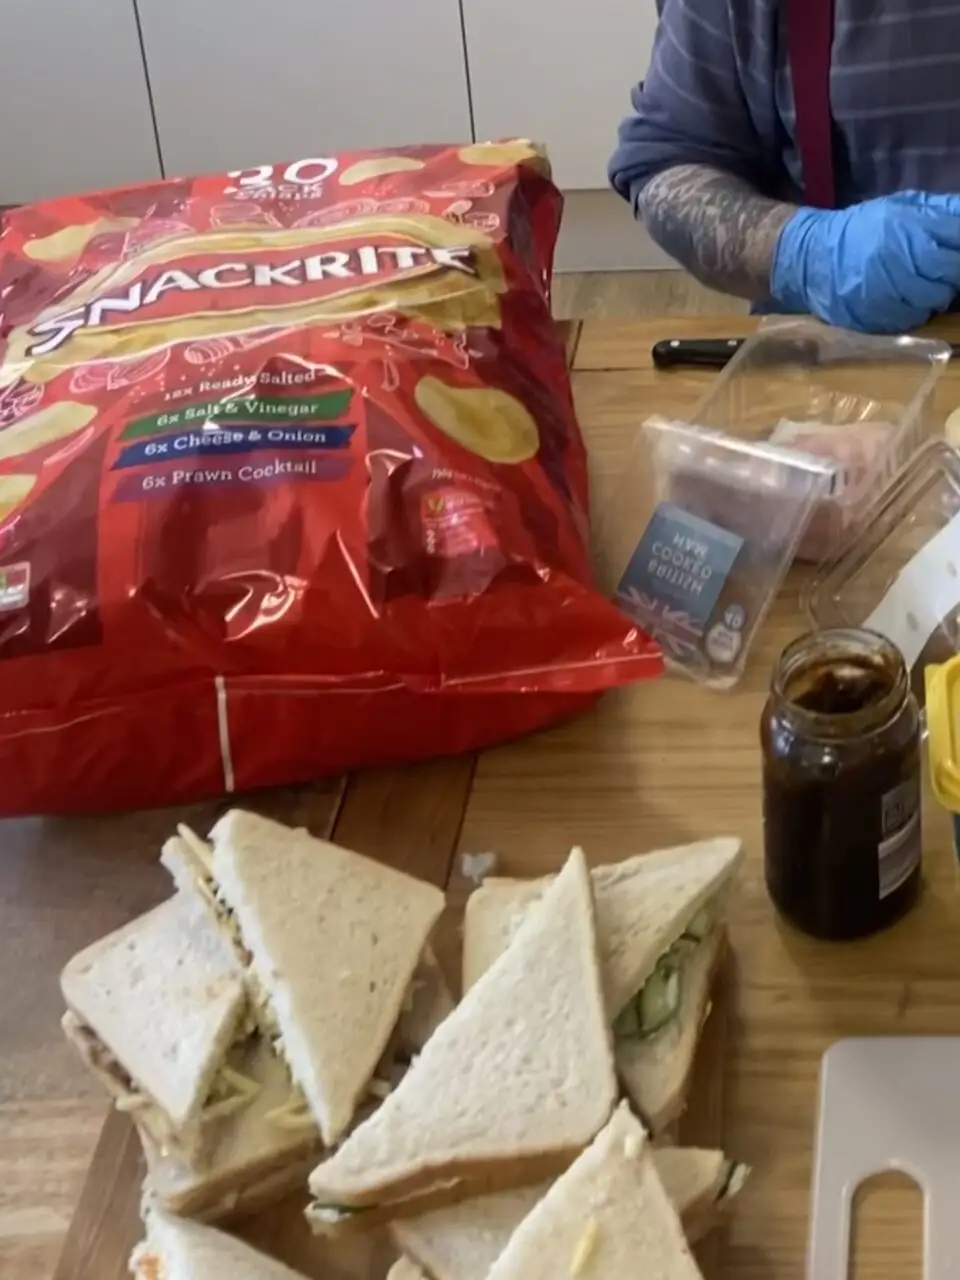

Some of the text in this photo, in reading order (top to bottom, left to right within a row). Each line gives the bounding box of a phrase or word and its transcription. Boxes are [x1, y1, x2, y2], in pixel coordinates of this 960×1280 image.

[25, 245, 475, 357] SNACKRITE
[199, 371, 257, 392] Ready
[259, 370, 316, 385] Salted
[156, 401, 320, 427] 6x Salt & Vinegar
[144, 429, 327, 456] 6x Cheese & Onion
[142, 458, 317, 491] 6x Prawn Cocktail
